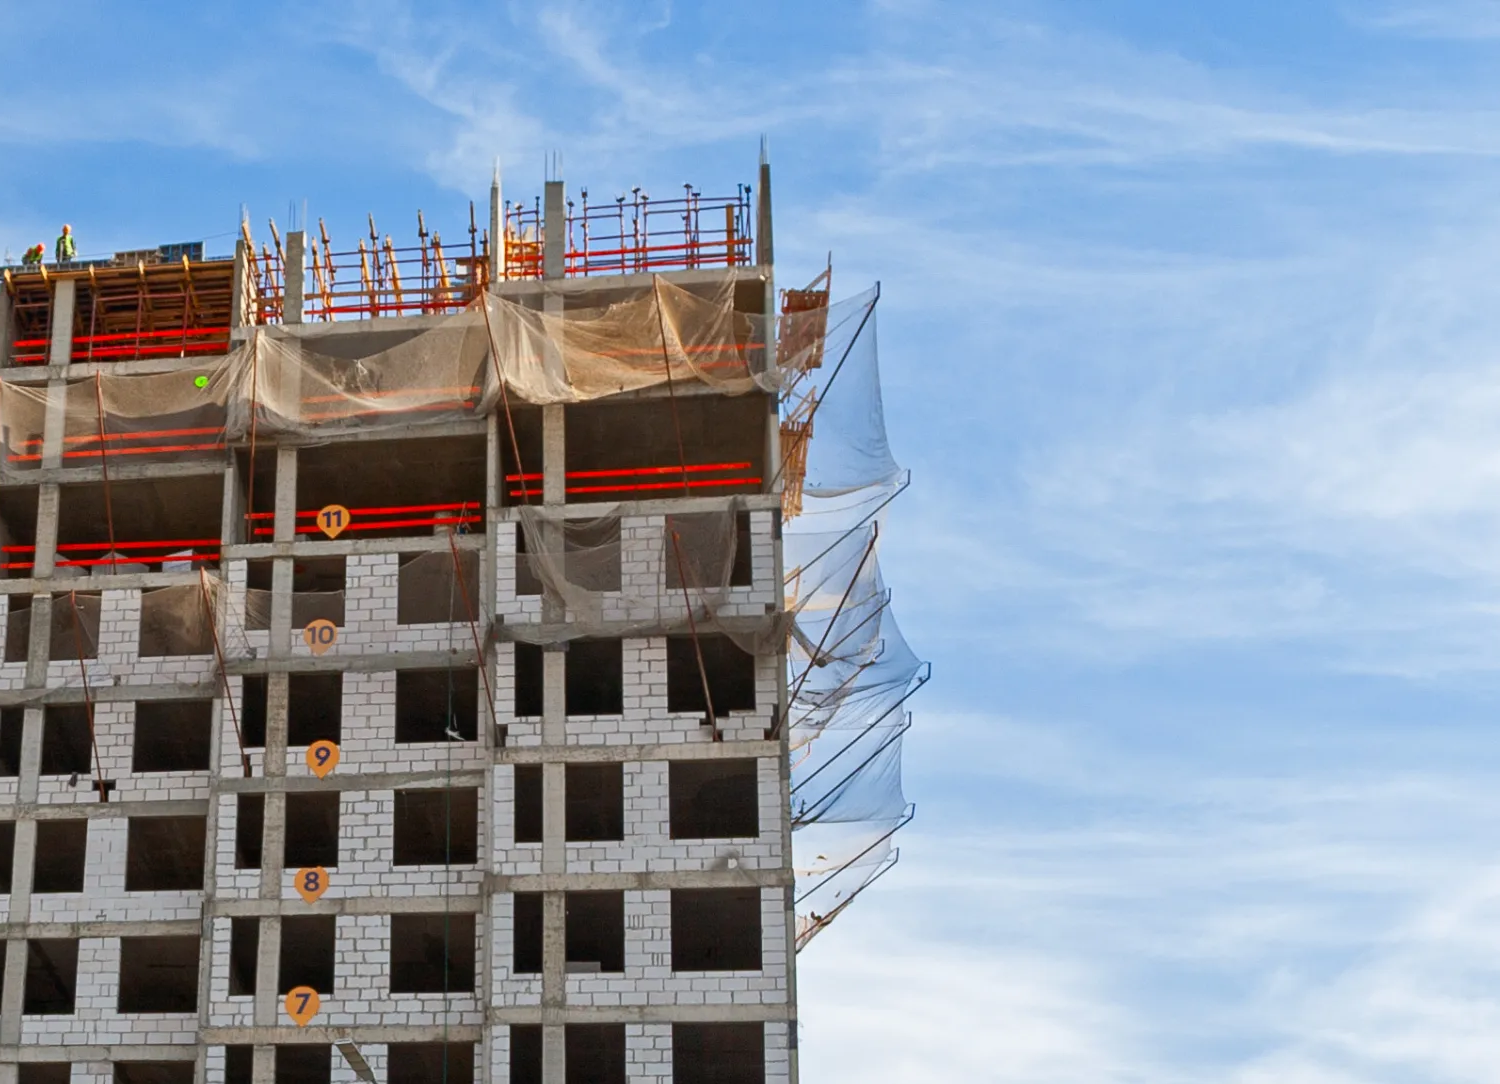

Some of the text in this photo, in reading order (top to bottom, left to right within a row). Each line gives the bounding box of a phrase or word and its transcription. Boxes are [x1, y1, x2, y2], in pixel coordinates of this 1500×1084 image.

[322, 510, 343, 528] 11
[307, 625, 334, 644] 10
[314, 746, 331, 767] 9
[303, 871, 320, 892] 8
[295, 993, 311, 1015] 7
